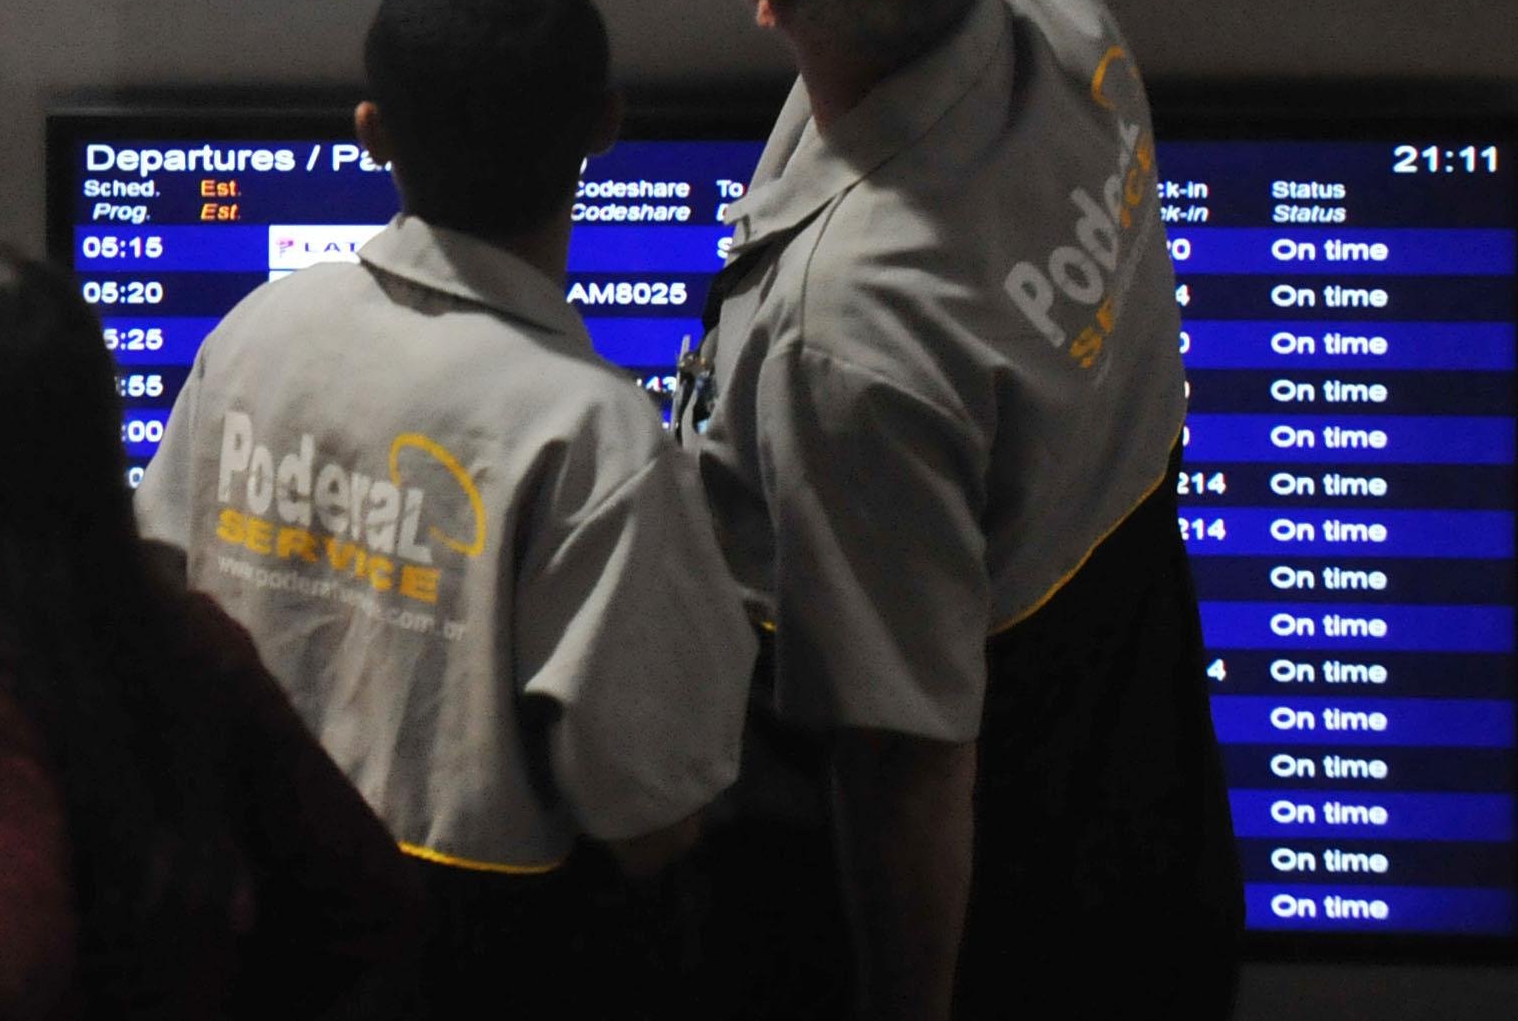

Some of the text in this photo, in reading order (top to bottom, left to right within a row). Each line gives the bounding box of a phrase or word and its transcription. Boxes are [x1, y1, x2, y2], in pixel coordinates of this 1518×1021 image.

[87, 145, 295, 177] Departures
[1394, 146, 1497, 172] 21:11
[83, 237, 163, 258] 05:15
[1272, 239, 1389, 260] On time
[83, 282, 163, 303] 05:20
[566, 283, 687, 304] AM8025
[216, 508, 441, 604] SERVICE
